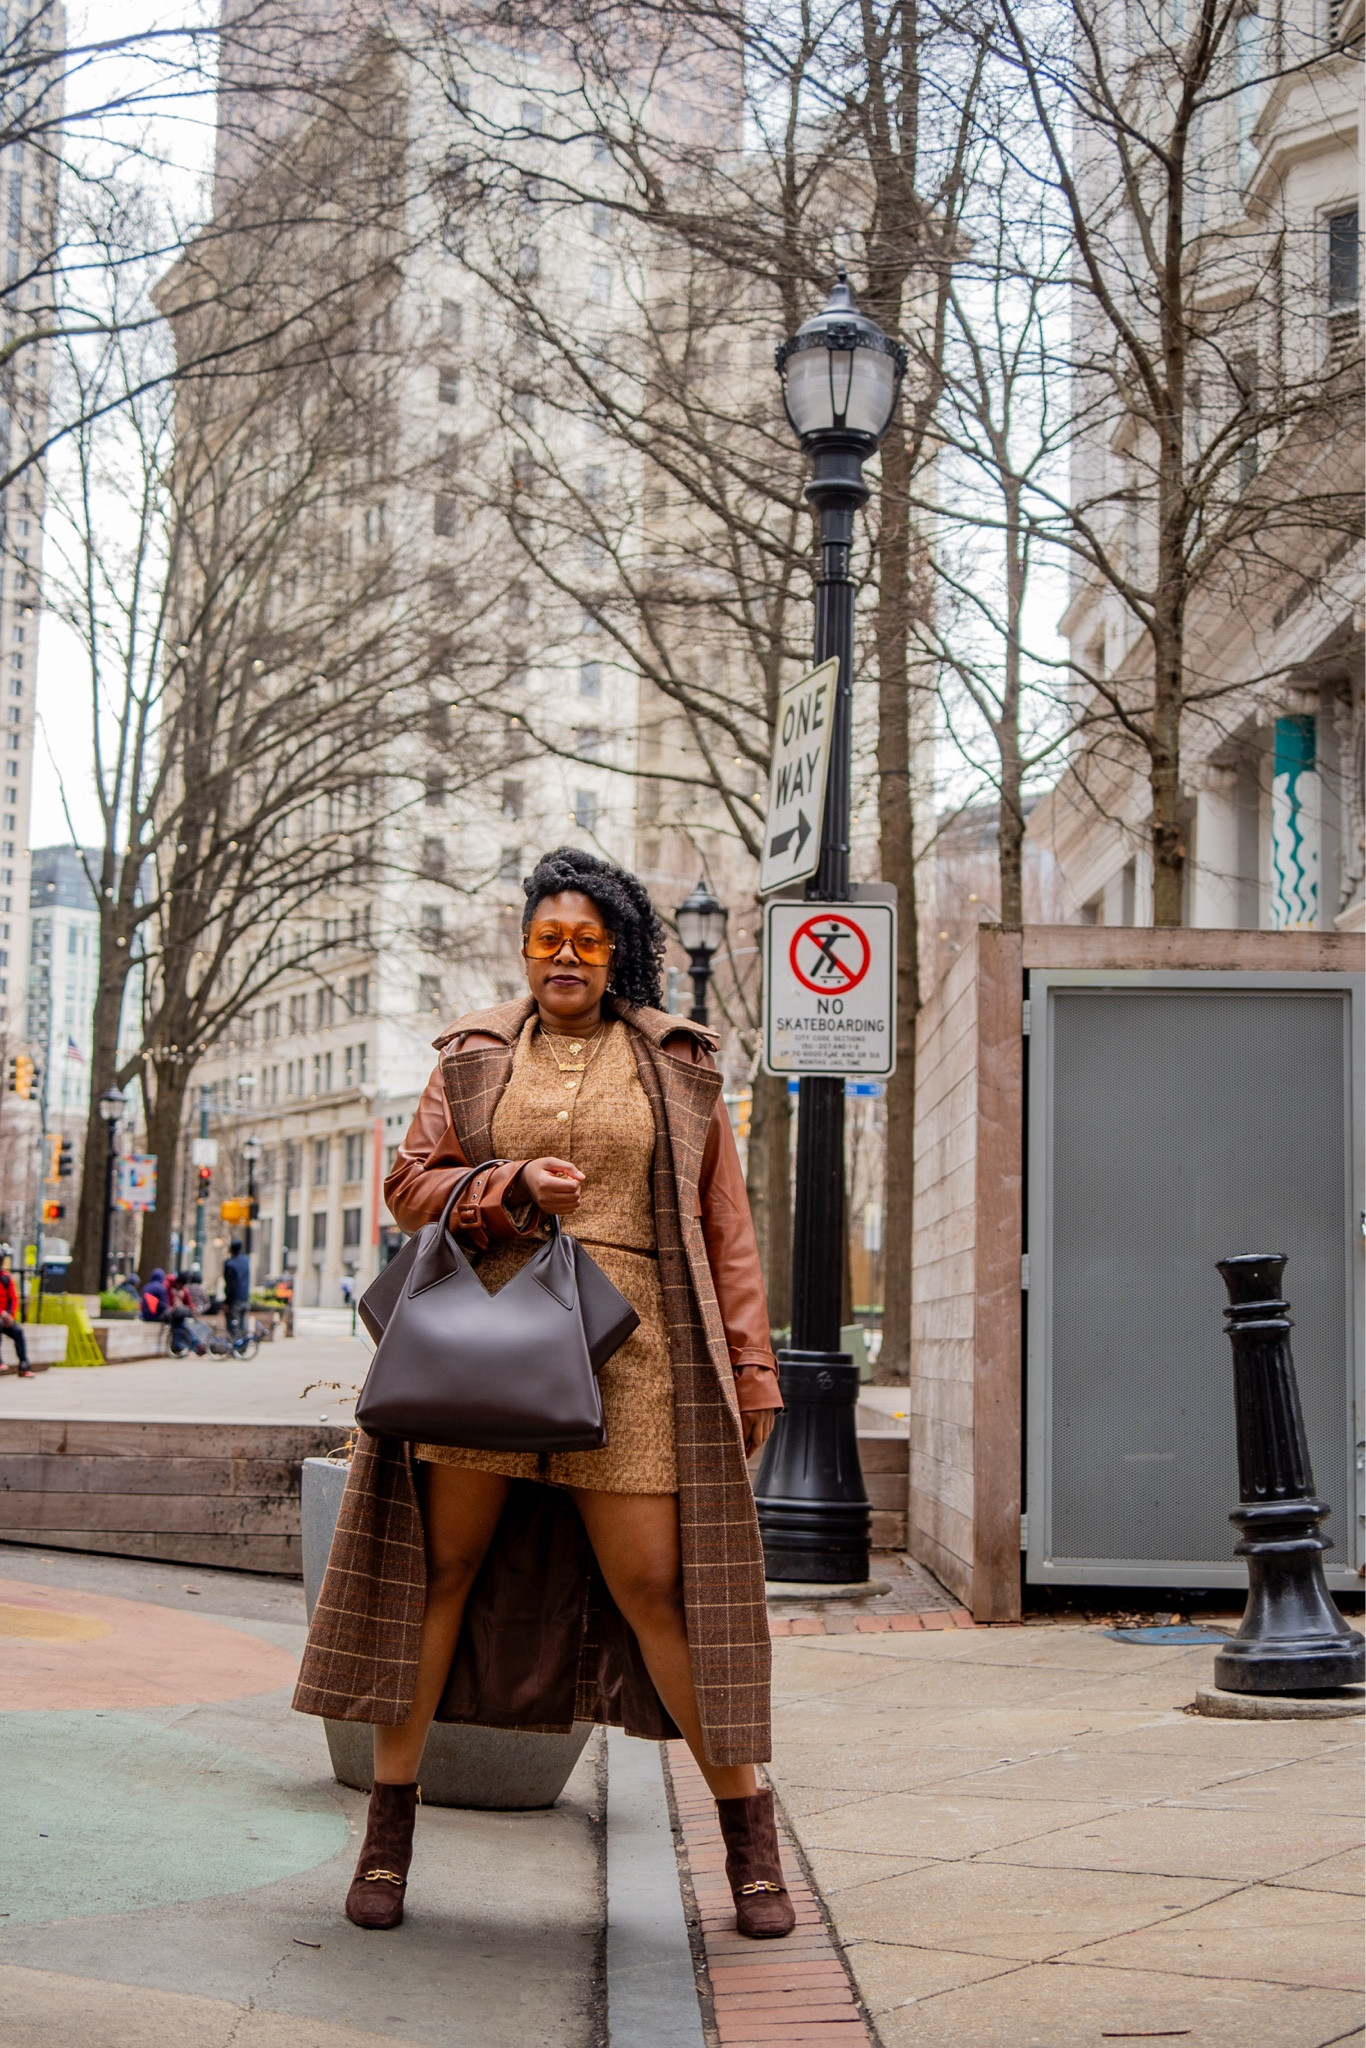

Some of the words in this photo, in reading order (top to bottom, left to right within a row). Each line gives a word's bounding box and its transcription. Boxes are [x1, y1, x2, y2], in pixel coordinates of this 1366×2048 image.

[782, 683, 828, 748] ONE
[775, 746, 821, 810] WAY
[776, 1018, 885, 1032] SKATEBOARDING
[817, 998, 844, 1015] NO
